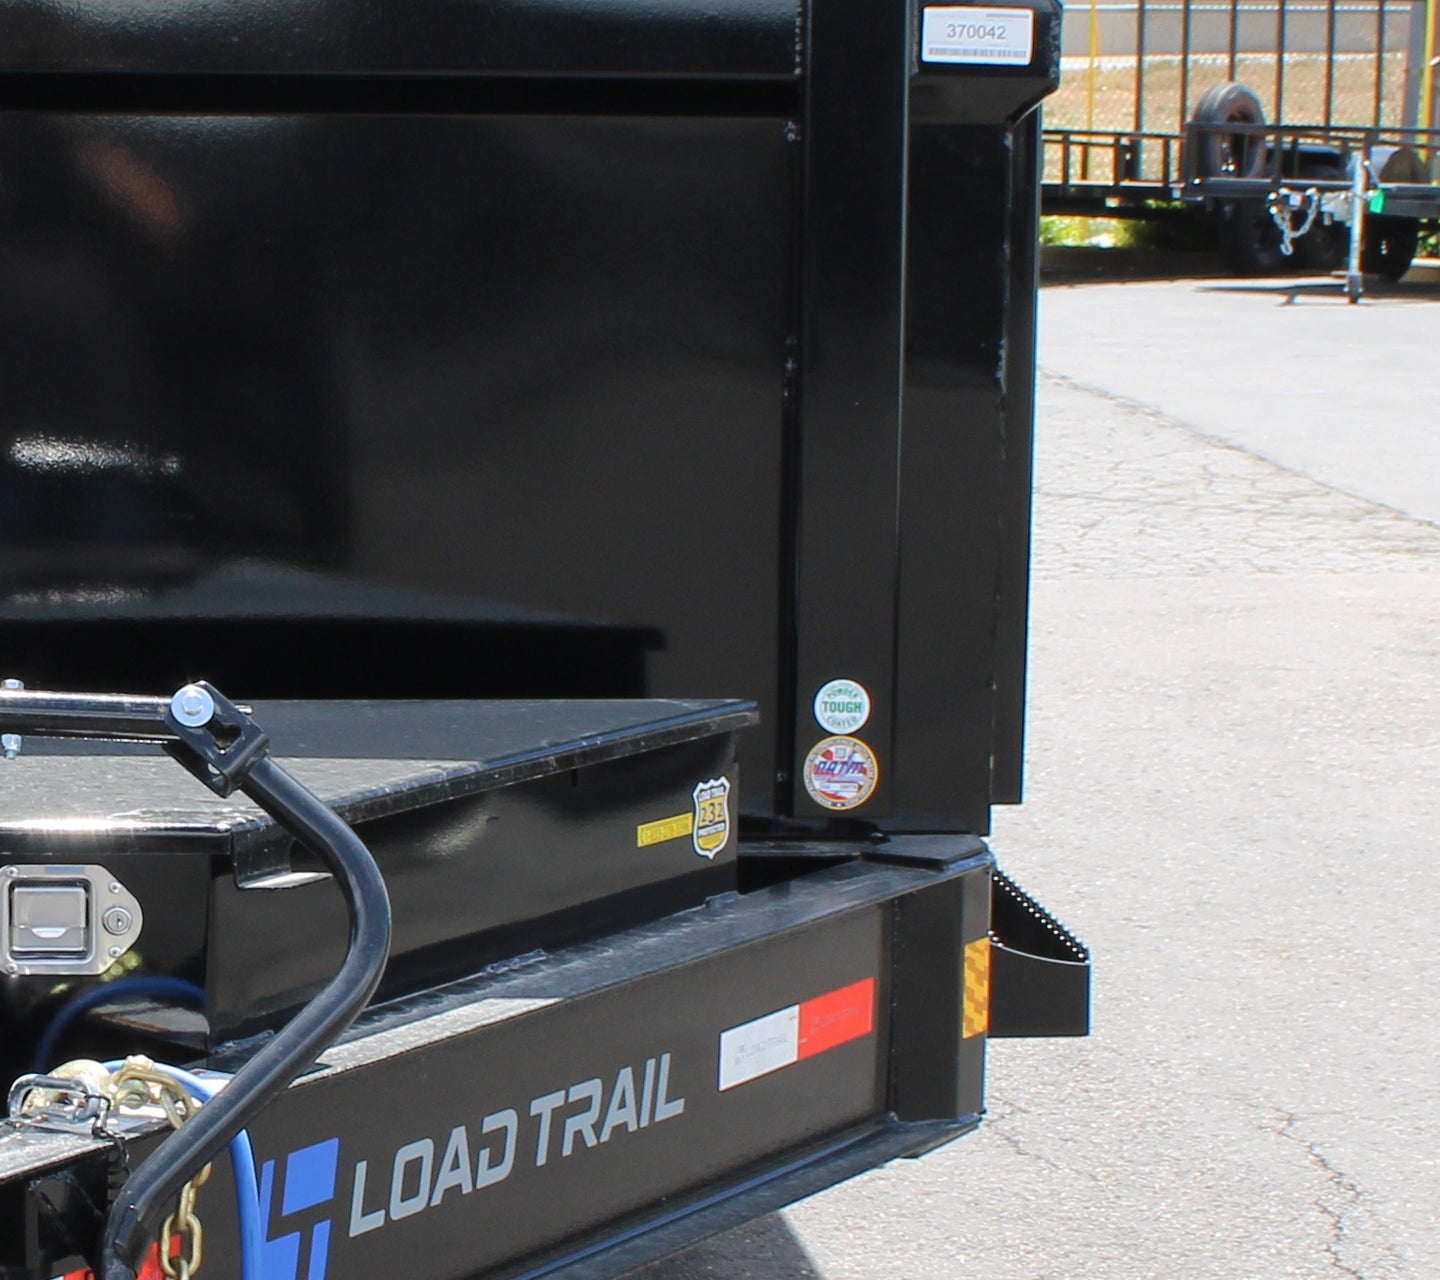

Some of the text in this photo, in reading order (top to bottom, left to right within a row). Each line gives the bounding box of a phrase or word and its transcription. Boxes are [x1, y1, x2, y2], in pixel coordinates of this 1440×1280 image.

[946, 24, 1007, 40] 370042
[822, 701, 862, 713] TOUGH
[348, 1053, 685, 1238] LOAD TRAIL
